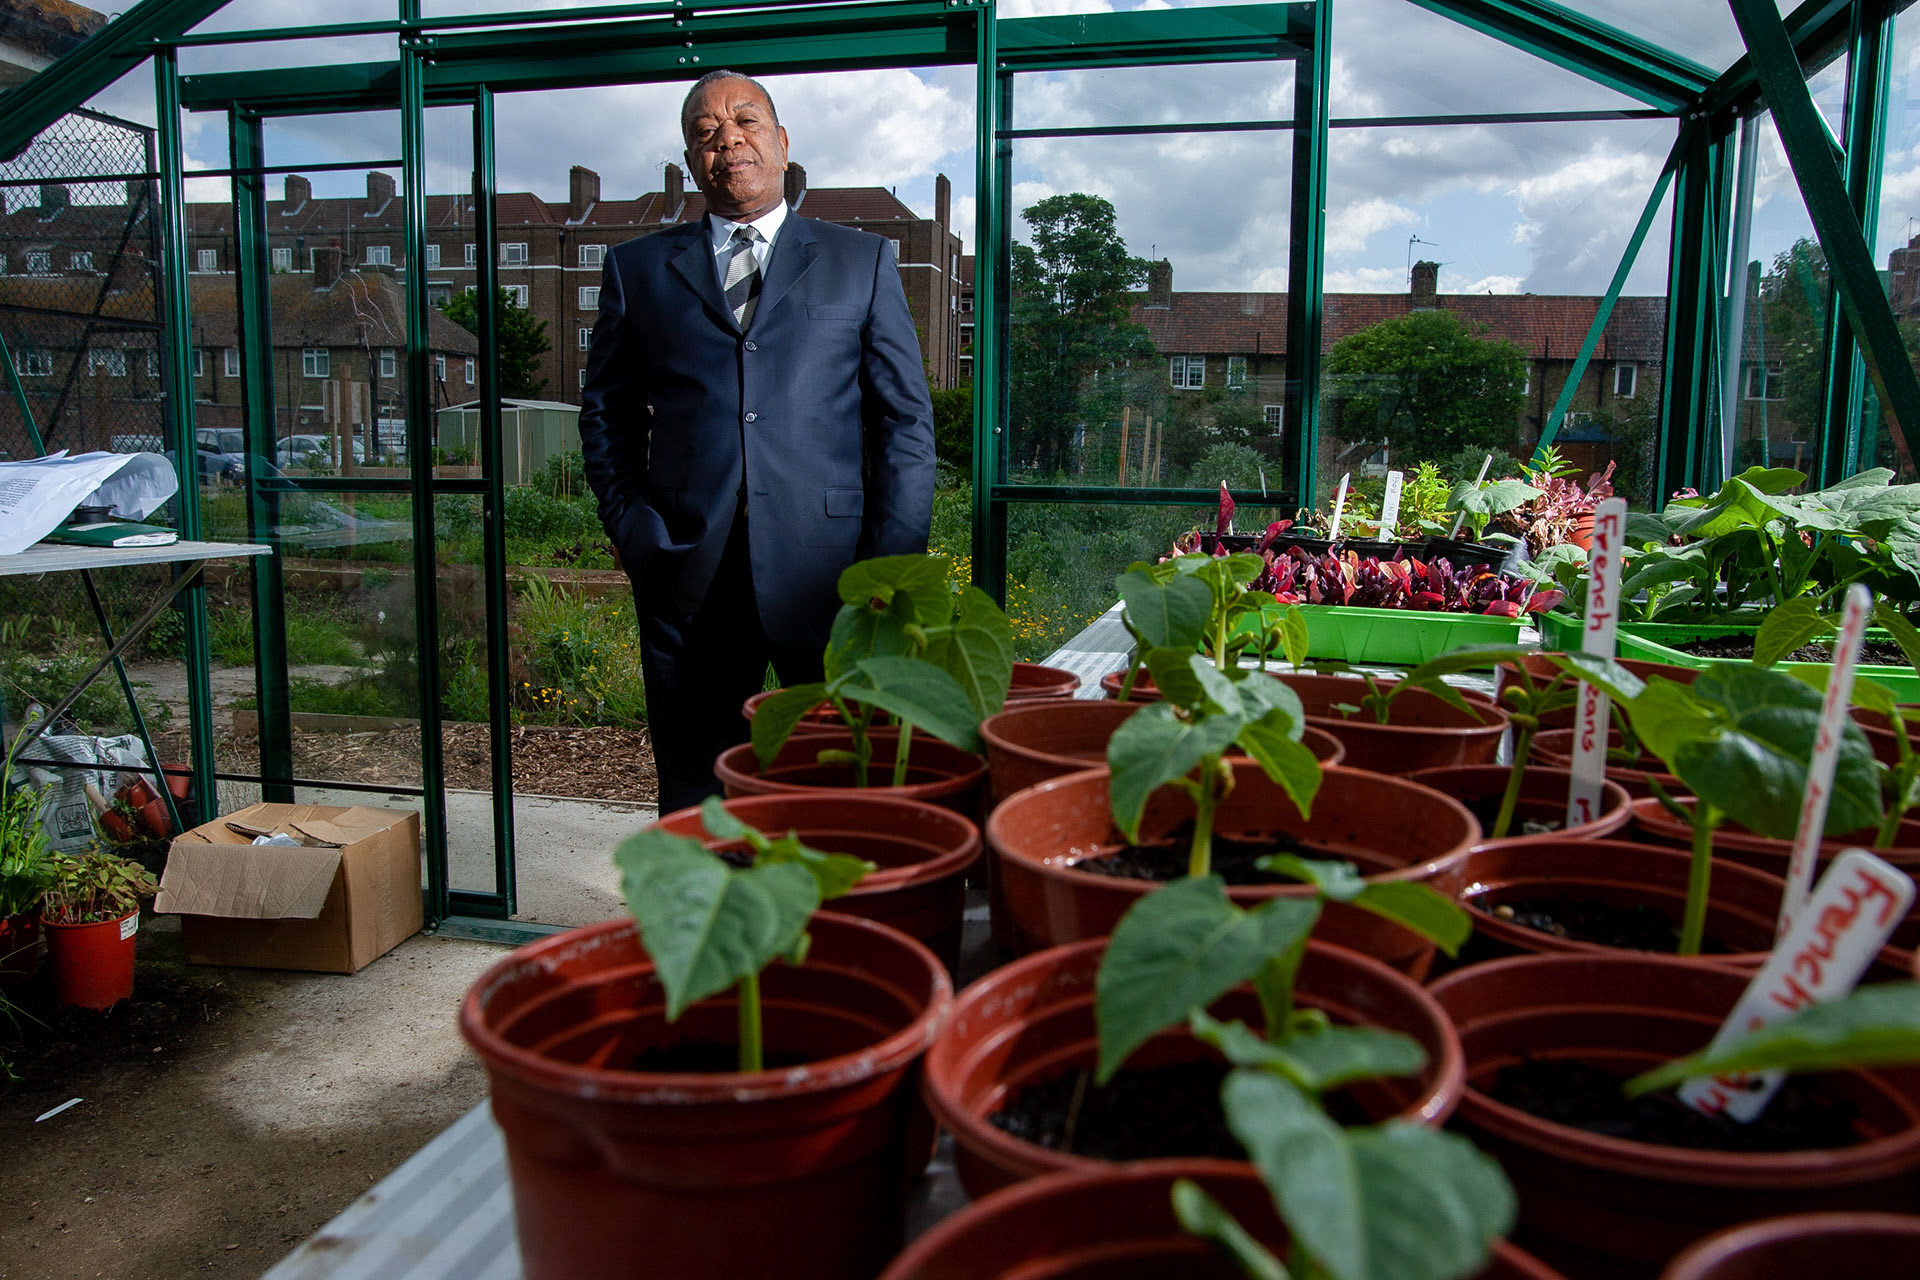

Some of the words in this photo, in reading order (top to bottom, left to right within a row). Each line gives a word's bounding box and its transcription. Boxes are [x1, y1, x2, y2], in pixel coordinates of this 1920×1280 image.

[1588, 513, 1619, 633] French
[1582, 684, 1600, 752] eans
[1769, 866, 1899, 1012] French
